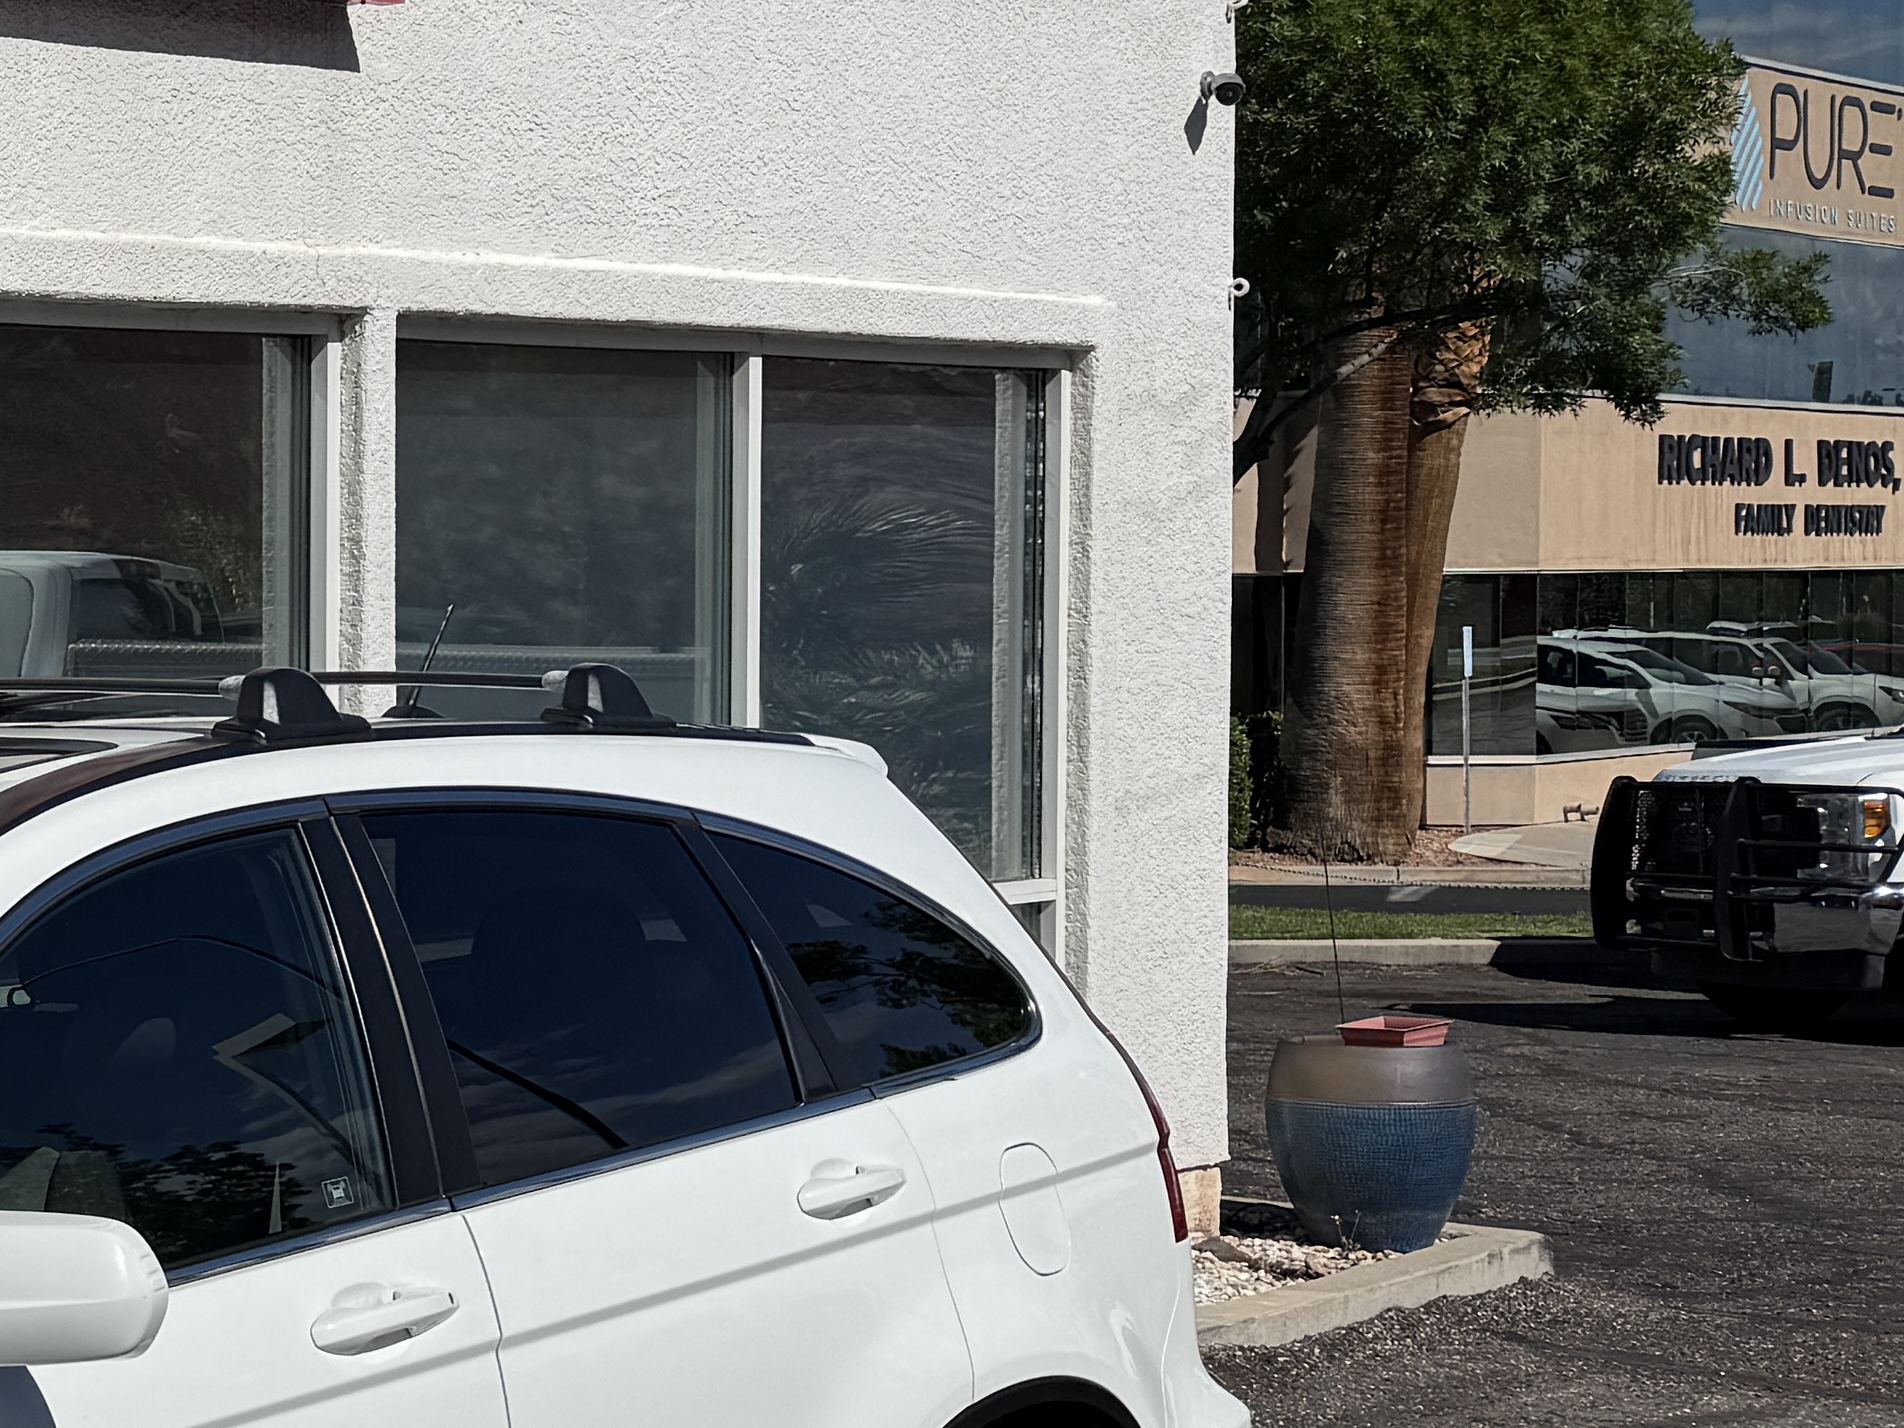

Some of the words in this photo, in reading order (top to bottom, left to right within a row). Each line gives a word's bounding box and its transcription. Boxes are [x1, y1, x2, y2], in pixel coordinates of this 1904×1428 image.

[1768, 198, 1839, 227] INFUSION
[1847, 209, 1897, 234] SUITES
[1658, 433, 1773, 487] RICHARD
[1784, 438, 1807, 487] L.
[1816, 439, 1902, 495] DENOS,
[1735, 503, 1797, 536] FAMILY
[1804, 504, 1887, 537] DENTISTRY
